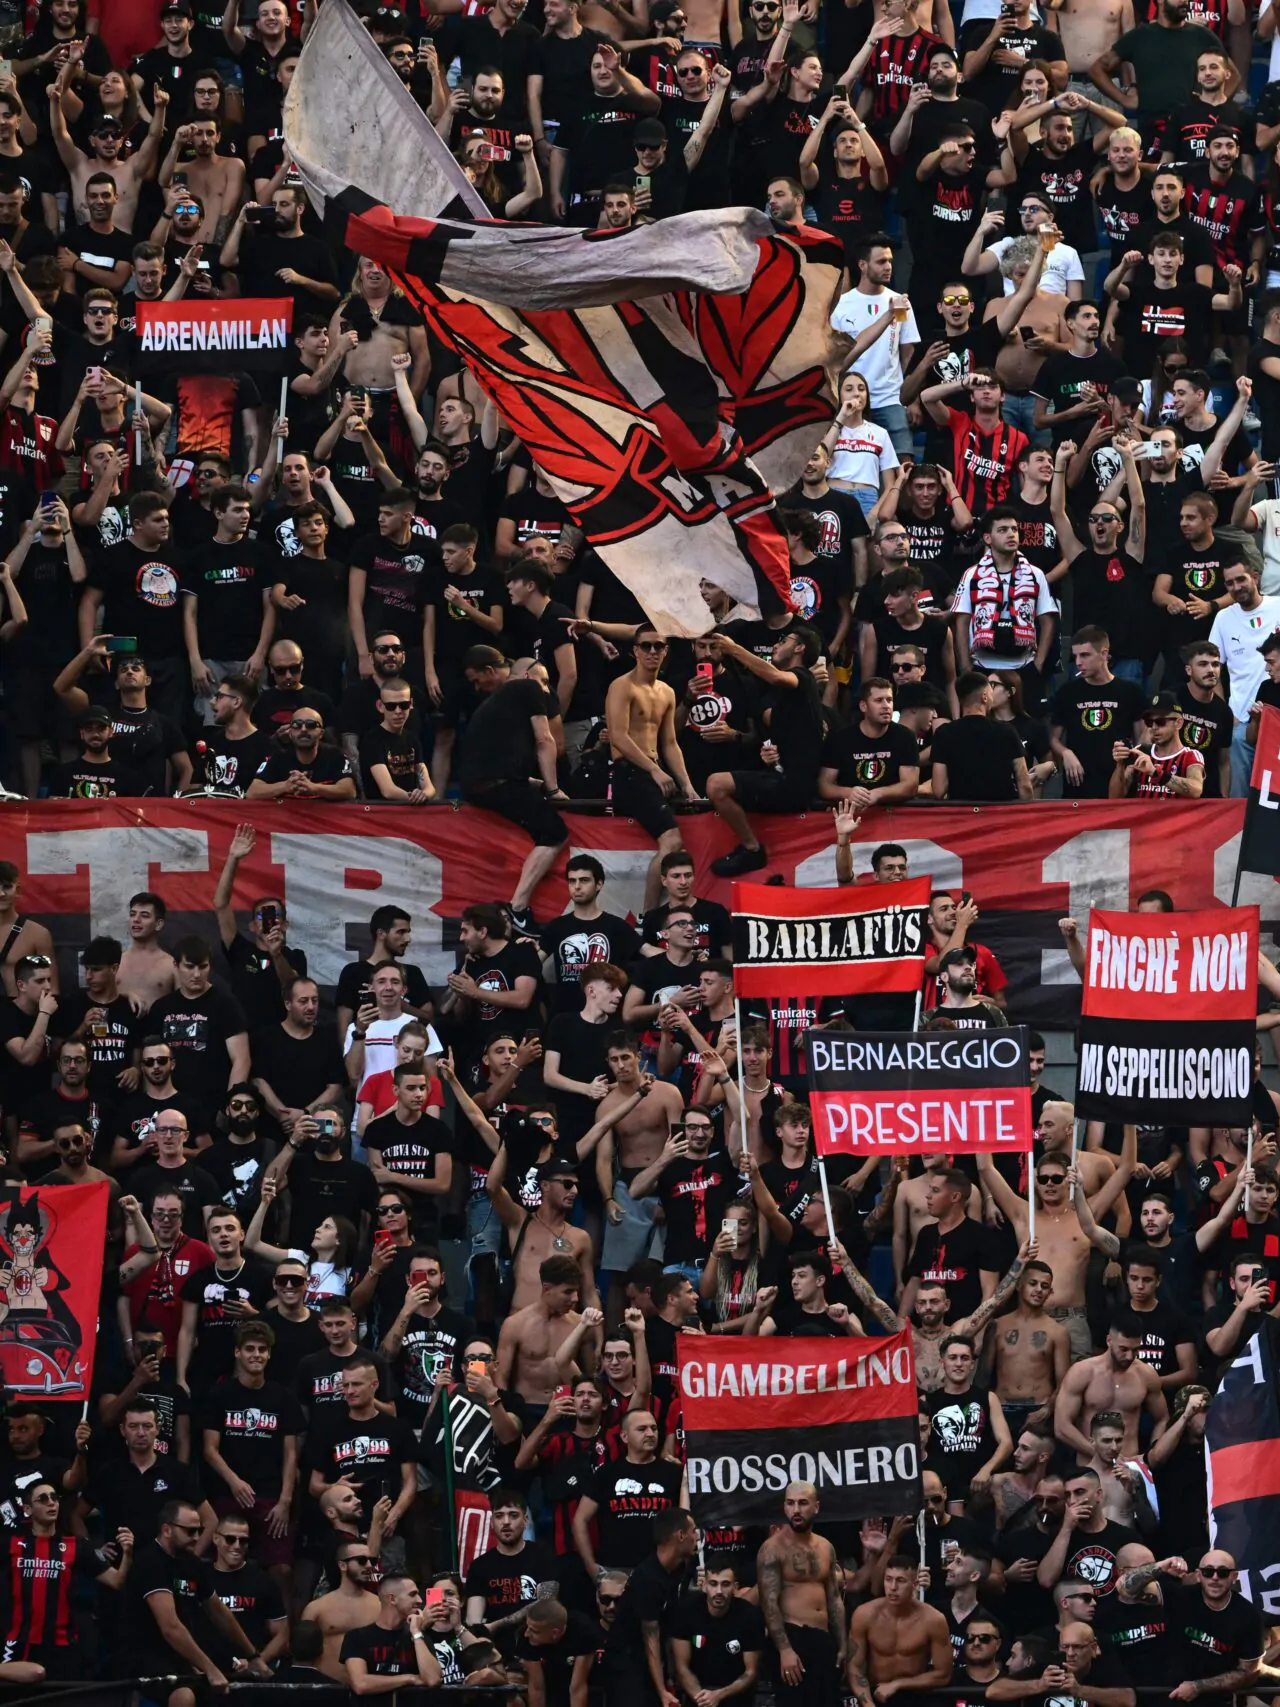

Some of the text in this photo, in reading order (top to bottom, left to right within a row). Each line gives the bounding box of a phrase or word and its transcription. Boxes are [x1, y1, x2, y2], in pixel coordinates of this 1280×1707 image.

[889, 62, 903, 74] Fly
[876, 72, 914, 86] Emirates
[1187, 210, 1231, 235] Emirates
[140, 317, 288, 352] ADRENAMILAN
[962, 447, 1006, 474] Emirates
[966, 461, 998, 481] FLY BETTER
[930, 525, 945, 536] SUD
[204, 566, 256, 580] CAMPIONI
[746, 903, 922, 960] BARLAFÜS
[1088, 928, 1249, 994] FINCHÈ NON
[770, 1008, 817, 1020] Emirates
[111, 1021, 129, 1036] SUD
[776, 1018, 811, 1029] FLY BETTER
[89, 1039, 126, 1049] ANDITI
[92, 1050, 125, 1062] ILANO
[811, 1036, 1022, 1072] BERNAREGGIO
[1079, 1042, 1251, 1101] MI SEPPELLISCONO
[825, 1098, 1017, 1145] PRESENTE
[381, 1144, 430, 1159] CURVA SUD
[385, 1160, 427, 1171] BANDITI
[1145, 1333, 1165, 1347] SUD
[681, 1346, 912, 1398] GIAMBELLINO
[259, 1412, 278, 1429] 99
[226, 1429, 243, 1437] Curva
[244, 1430, 256, 1438] Sud
[940, 1434, 982, 1448] CAMPIONI
[369, 1438, 391, 1453] 99
[943, 1444, 977, 1453] D'ITALIA
[686, 1442, 919, 1495] ROSSONERO
[16, 1556, 67, 1571] Emirates
[22, 1568, 60, 1579] FLY BETTER
[1111, 1622, 1166, 1642] CAMPIONI
